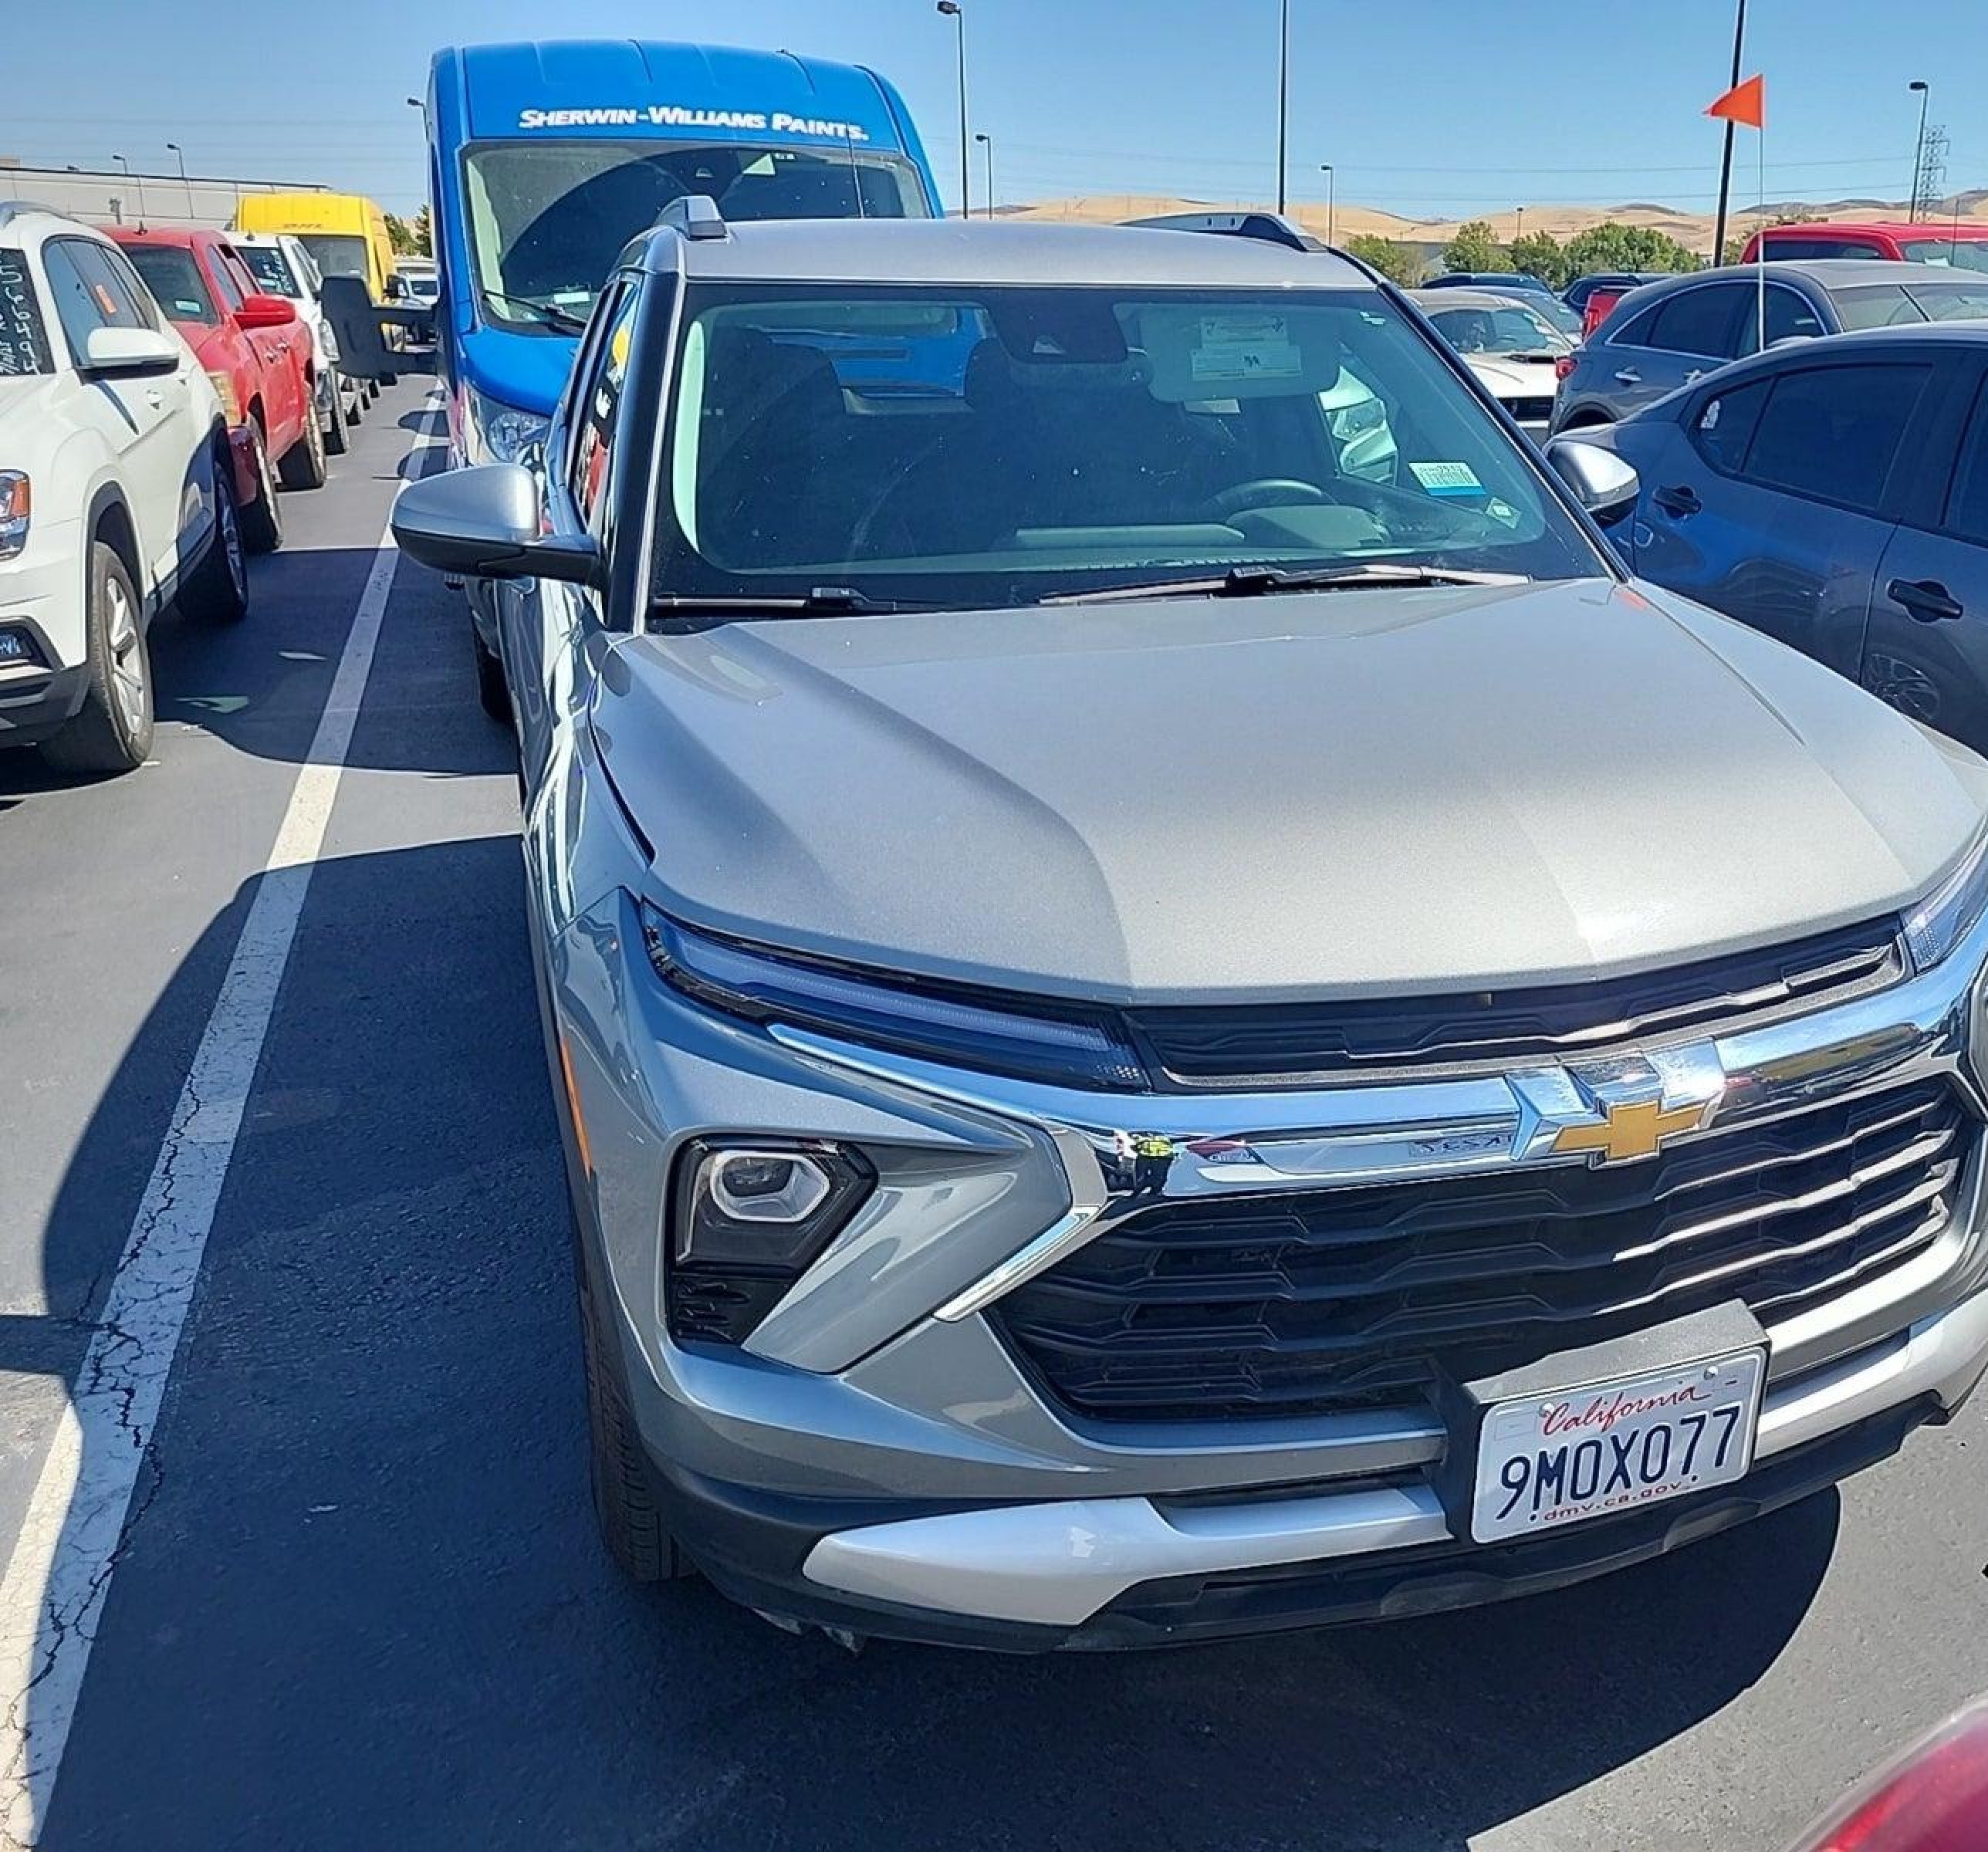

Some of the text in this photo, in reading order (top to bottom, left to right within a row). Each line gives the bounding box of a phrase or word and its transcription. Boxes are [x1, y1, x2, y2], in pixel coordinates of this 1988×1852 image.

[518, 106, 766, 129] SHERWIN-WILLIAMS
[1543, 1381, 1712, 1436] California
[1496, 1404, 1741, 1521] 9MOX077
[1543, 1481, 1682, 1522] dmv.ca.gov
